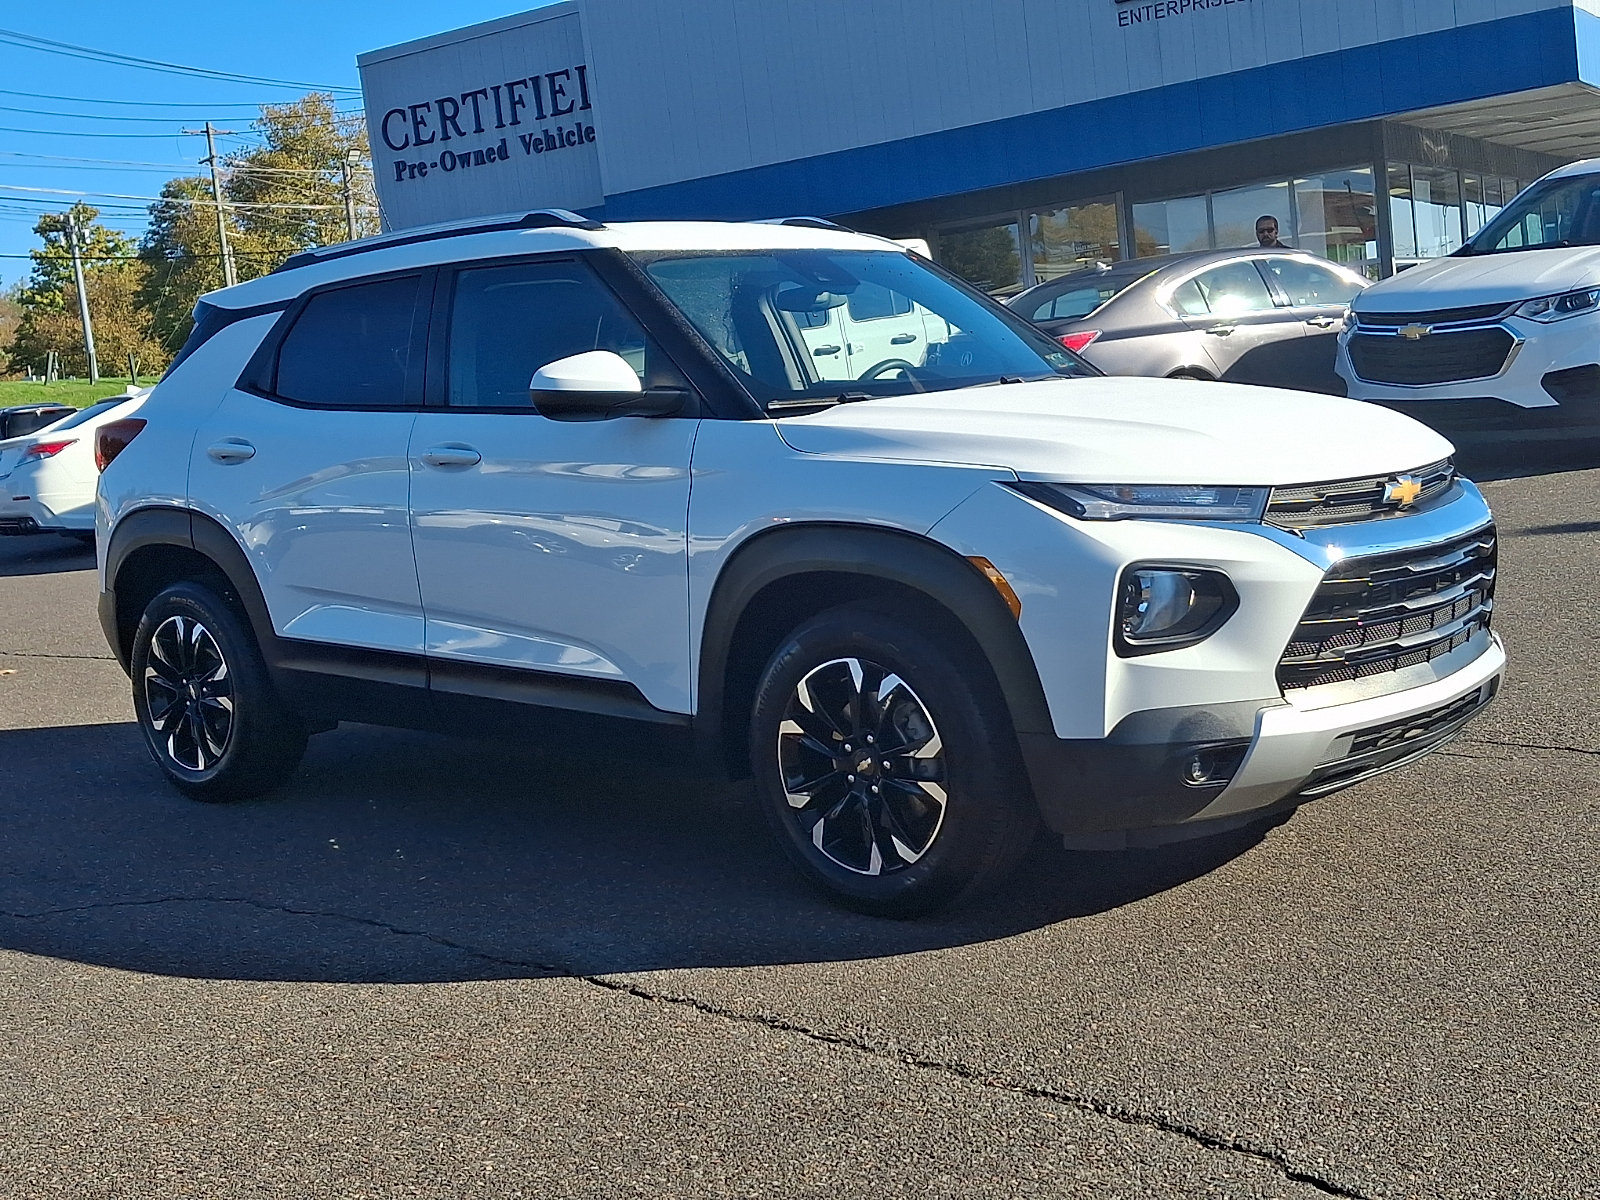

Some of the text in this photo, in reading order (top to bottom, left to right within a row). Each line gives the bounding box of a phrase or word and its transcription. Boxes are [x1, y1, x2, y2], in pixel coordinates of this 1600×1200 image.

[1117, 0, 1245, 27] ENTERPRI
[393, 122, 596, 182] Pre-Owned Vehicle
